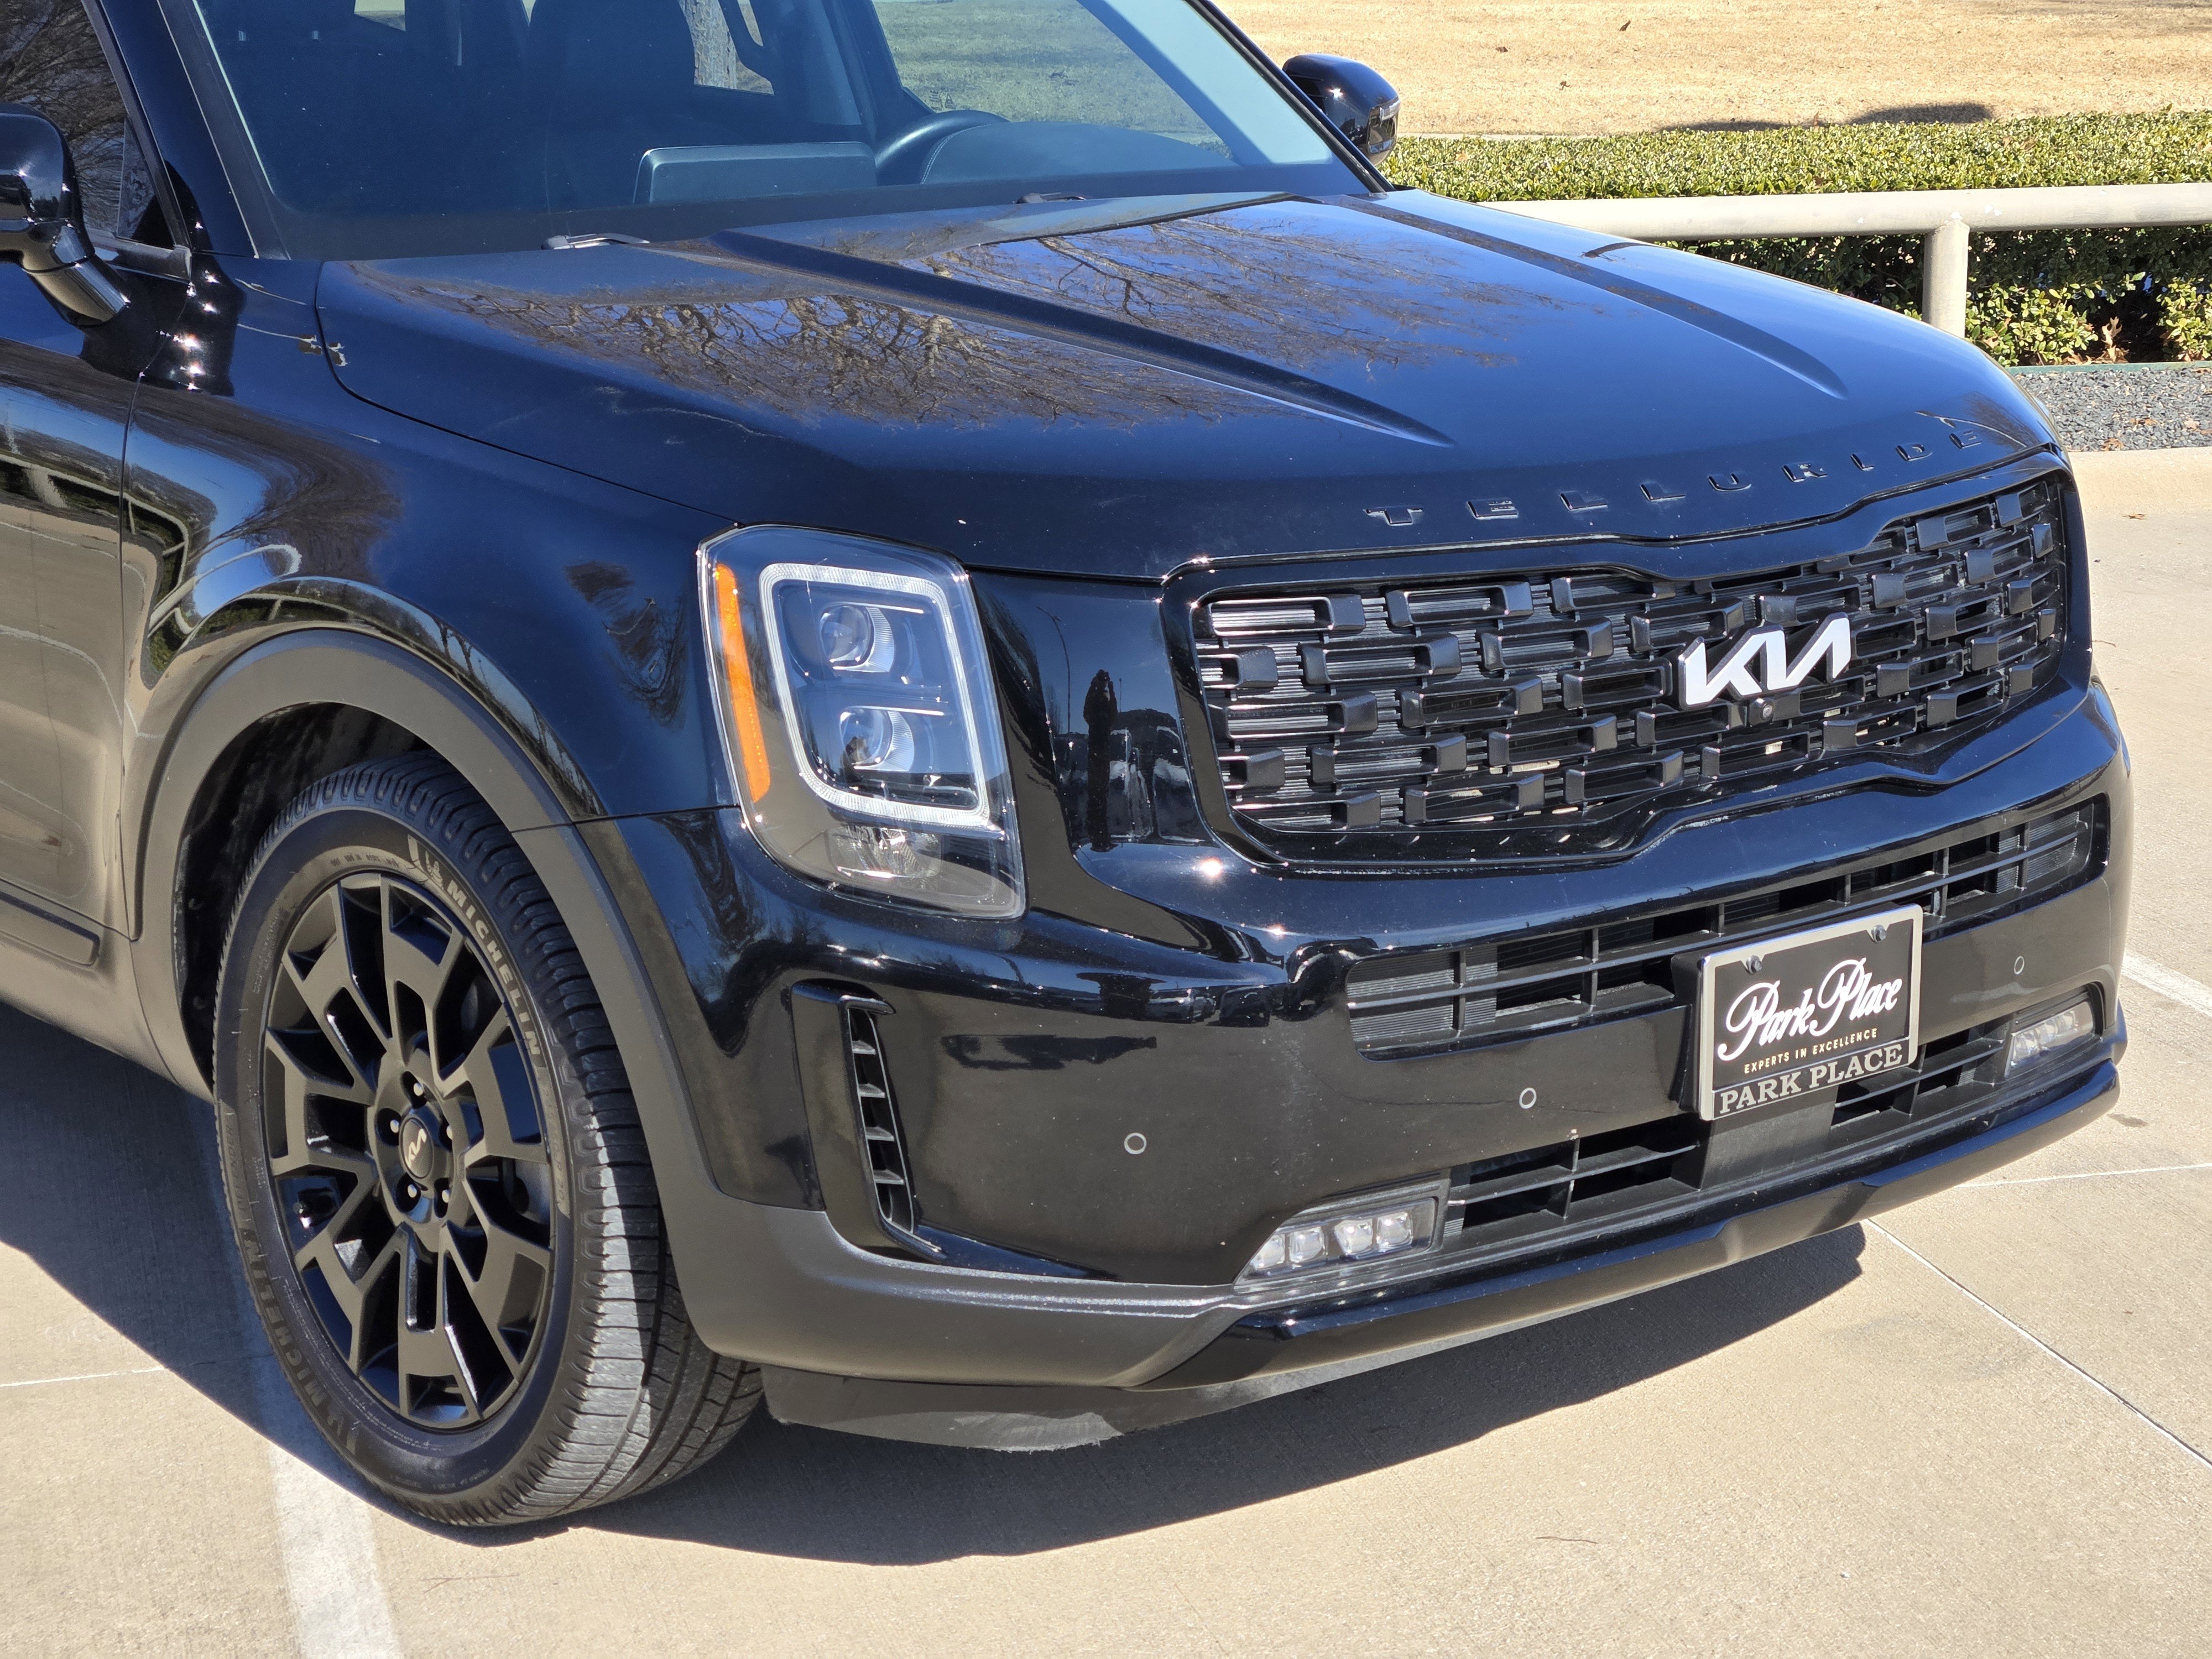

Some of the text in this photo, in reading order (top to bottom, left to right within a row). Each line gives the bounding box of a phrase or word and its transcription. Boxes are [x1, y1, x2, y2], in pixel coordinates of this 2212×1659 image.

[1363, 429, 1983, 525] TELLURIDE
[1679, 612, 1851, 708] KIA
[447, 880, 540, 1055] MICHELIN
[1718, 957, 1902, 1061] Park Place
[1720, 1044, 1902, 1114] PARK PLACE
[1744, 1028, 1877, 1074] EXPERTS IN EXCELLENCE
[243, 1239, 327, 1407] MICHELIN
